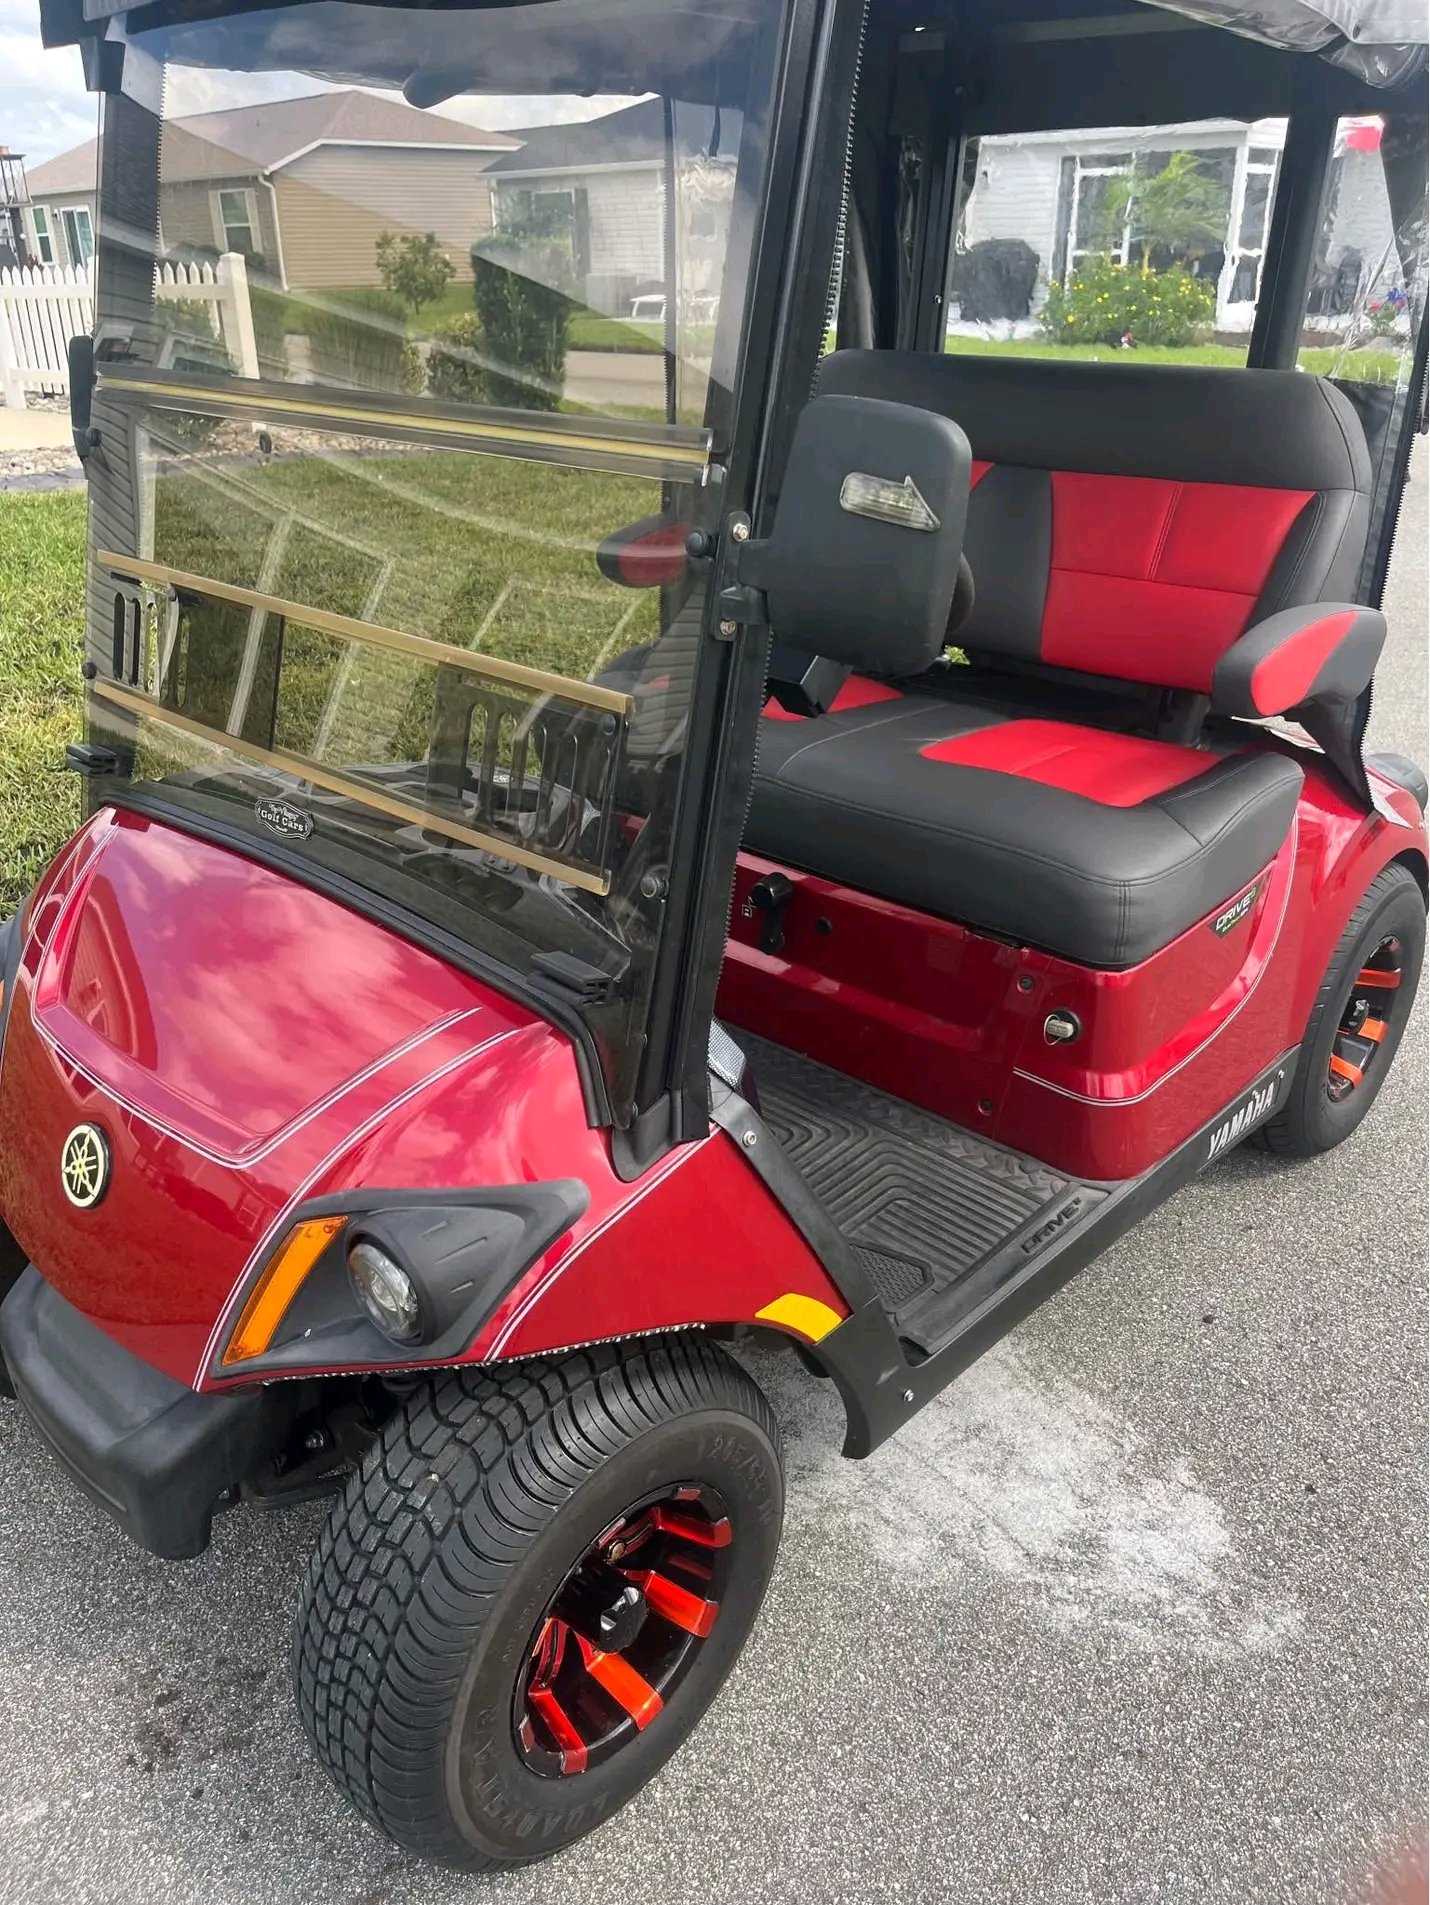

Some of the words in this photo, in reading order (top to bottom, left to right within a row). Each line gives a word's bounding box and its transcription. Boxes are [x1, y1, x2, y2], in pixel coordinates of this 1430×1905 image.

[260, 809, 280, 823] Golf
[282, 816, 304, 832] Cars
[1207, 1081, 1275, 1160] YAMAHA
